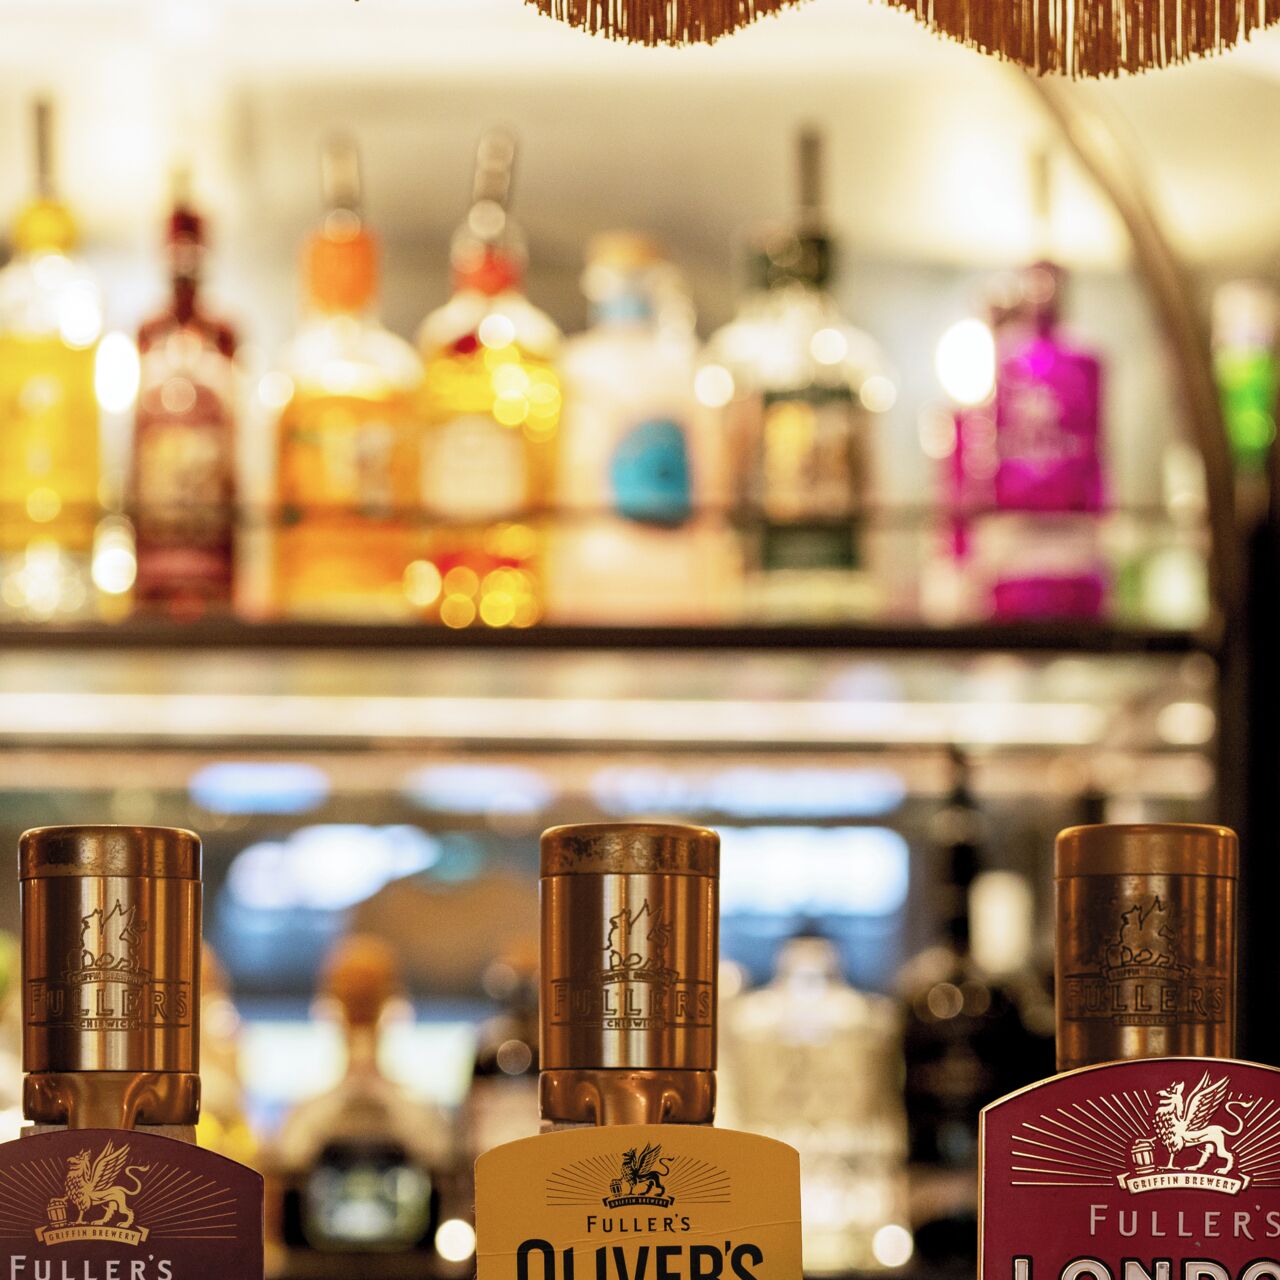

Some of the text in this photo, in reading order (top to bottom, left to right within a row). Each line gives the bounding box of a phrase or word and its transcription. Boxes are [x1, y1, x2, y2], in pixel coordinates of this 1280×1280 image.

[1132, 1176, 1236, 1190] GRIFFIN BREWERY
[587, 1213, 691, 1233] FULLER'S
[48, 1229, 136, 1241] GRIFFIN BREWERY
